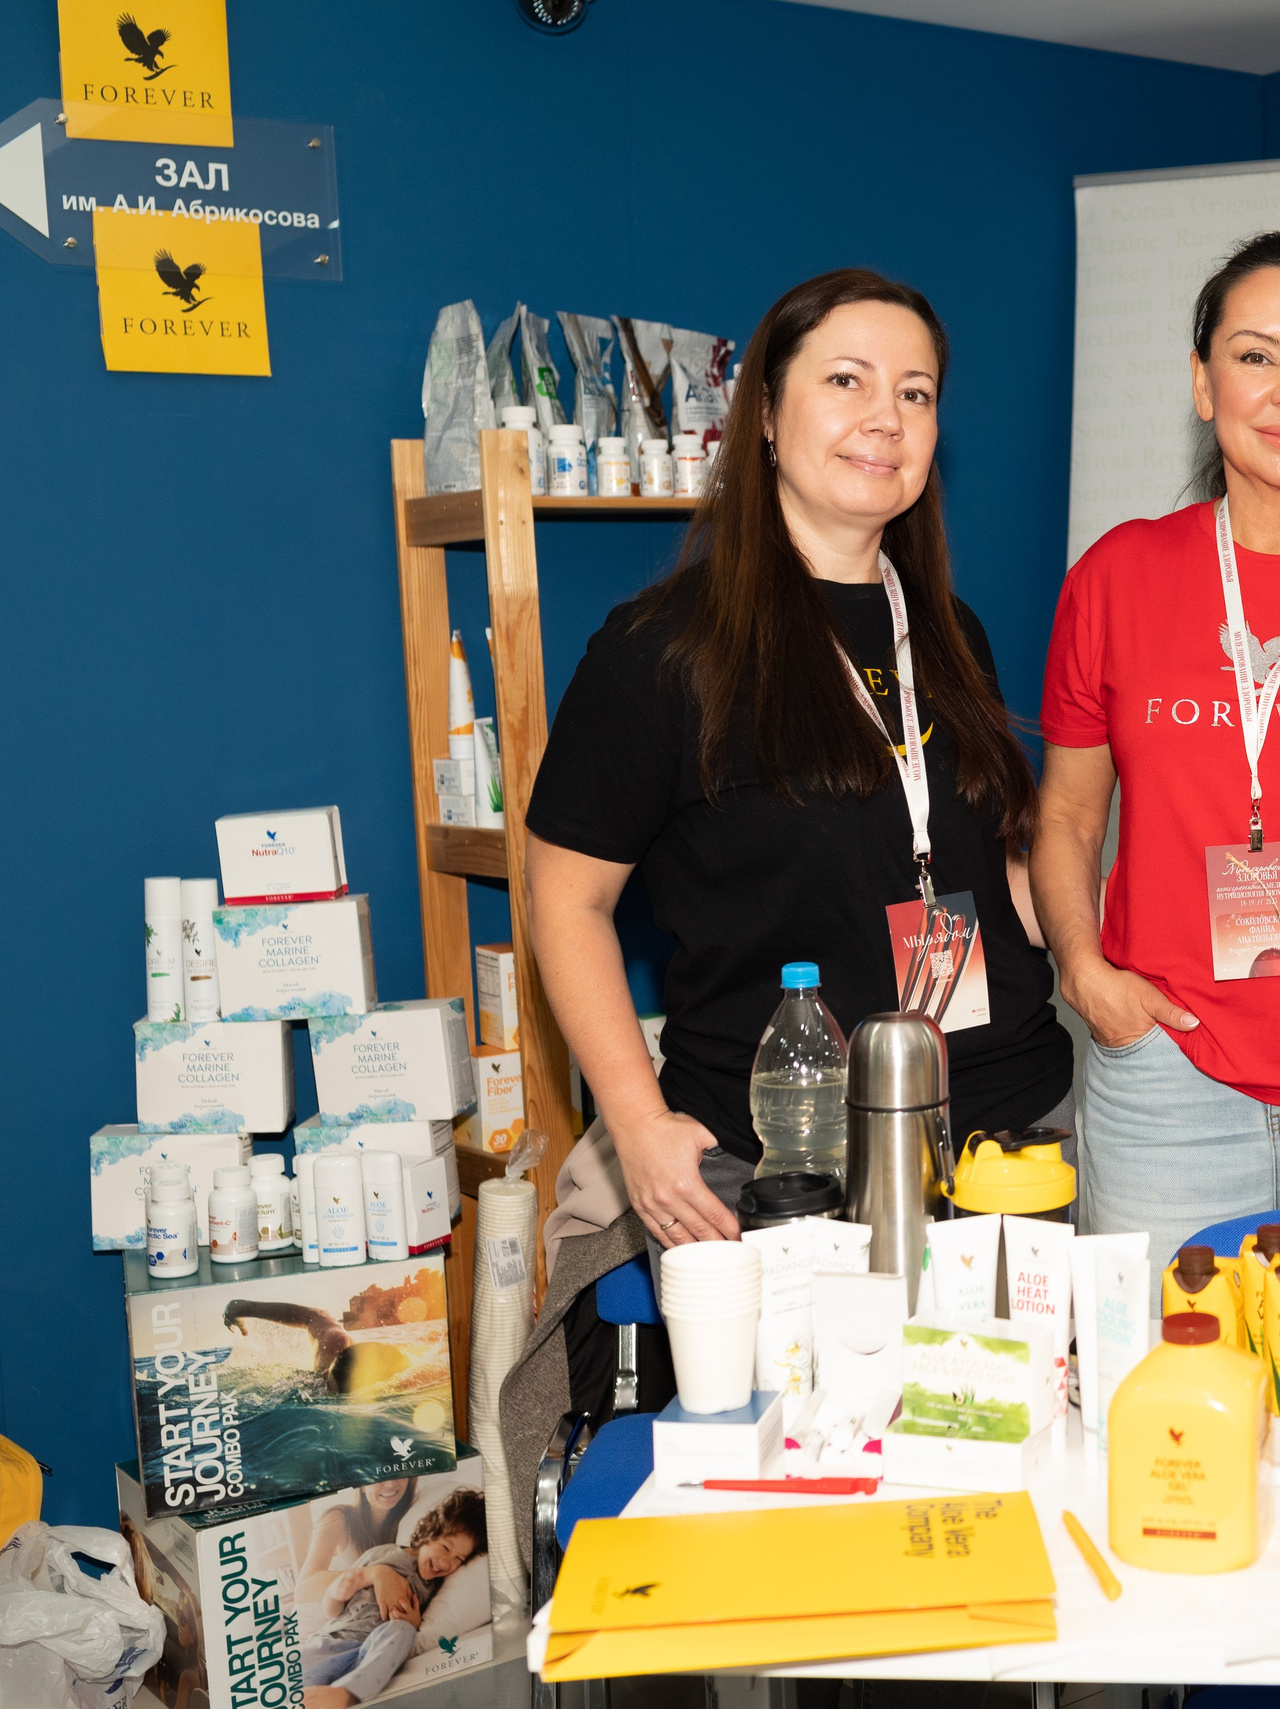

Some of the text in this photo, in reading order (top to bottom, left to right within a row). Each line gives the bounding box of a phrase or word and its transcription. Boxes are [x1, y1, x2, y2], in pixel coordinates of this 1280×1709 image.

[83, 84, 215, 109] FOREVER
[155, 157, 230, 191] ЗАЛ
[62, 193, 320, 229] им. А.И. Абрикосова
[1109, 202, 1174, 223] Korea
[122, 317, 251, 339] FOREVER
[261, 935, 313, 946] FOREVER
[266, 945, 309, 956] MARINE
[185, 958, 217, 969] DESIRE
[258, 956, 320, 968] COLLAGEN
[353, 1042, 400, 1053] FOREVER
[182, 1052, 235, 1062] FOREVER
[358, 1052, 397, 1063] MARINE
[186, 1063, 230, 1072] MARINE
[351, 1062, 407, 1074] COLLAGEN
[178, 1073, 240, 1083] COLLAGEN
[486, 1074, 522, 1088] Foreve
[487, 1085, 514, 1097] Fiber
[327, 1206, 348, 1214] ALOE
[1017, 1271, 1050, 1287] ALOE
[1016, 1284, 1050, 1301] HEAT
[1010, 1297, 1057, 1316] LOTION
[151, 1301, 195, 1507] START YOUR
[186, 1351, 226, 1501] JOURNEY
[220, 1389, 244, 1498] COMBO PAK
[375, 1457, 436, 1475] FOREVER
[218, 1531, 251, 1627] YOUR
[283, 1610, 300, 1648] PAK
[250, 1577, 288, 1709] OURNEY
[226, 1634, 259, 1709] TART
[425, 1651, 478, 1676] FOREVER
